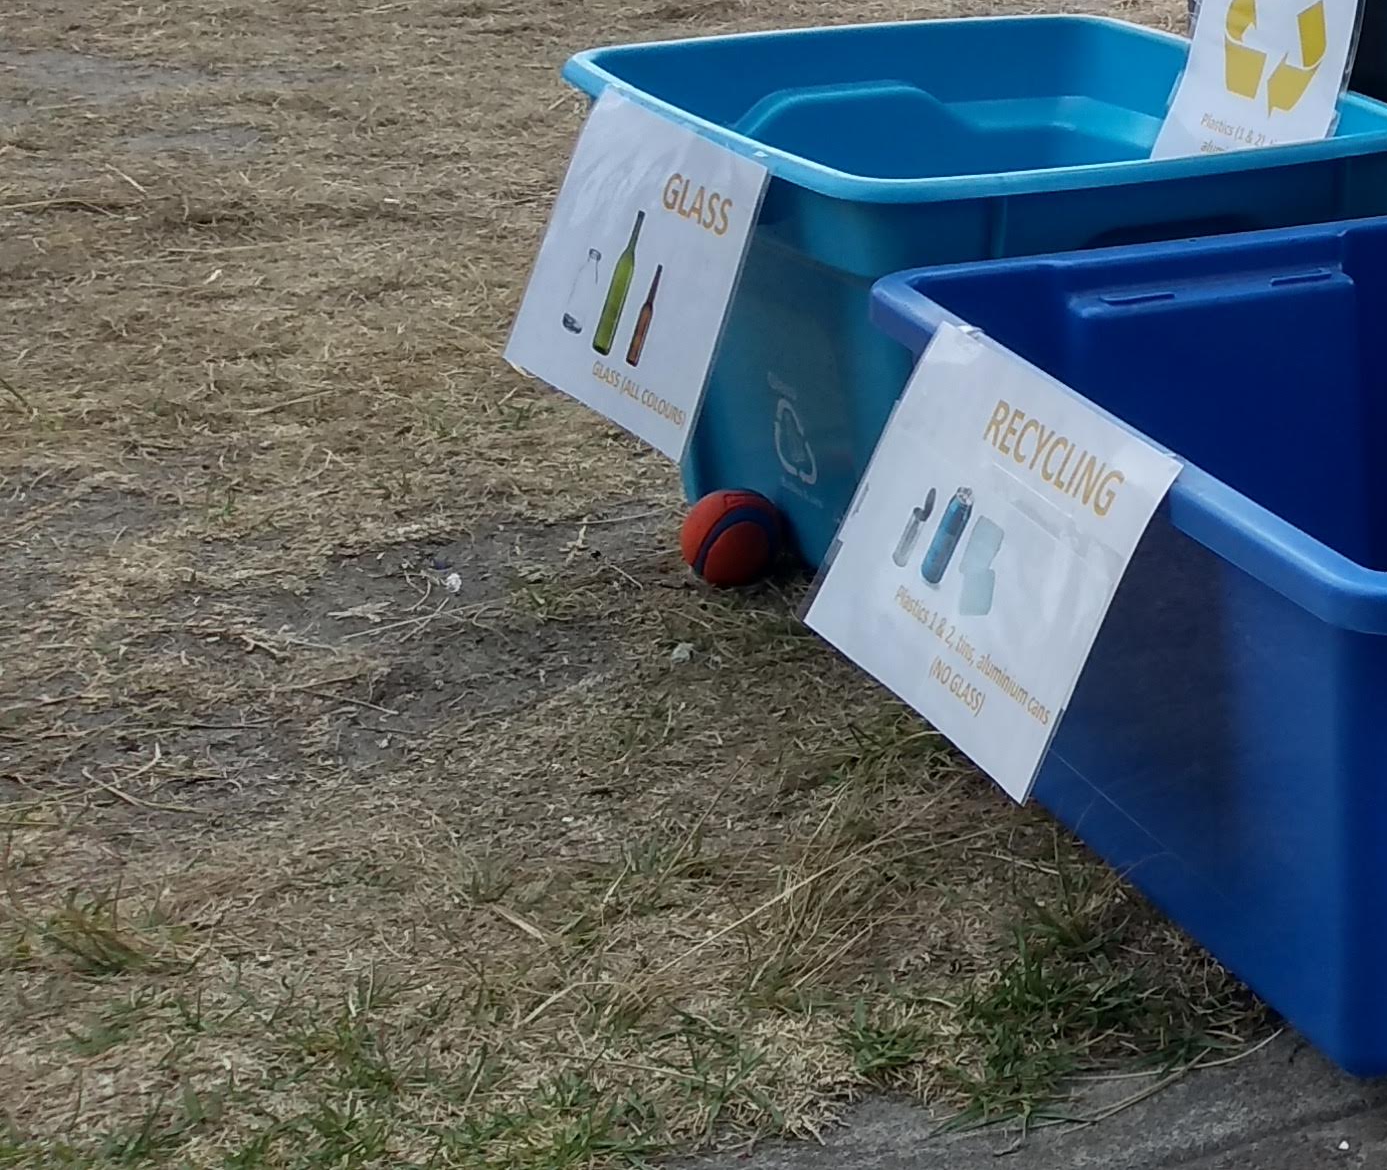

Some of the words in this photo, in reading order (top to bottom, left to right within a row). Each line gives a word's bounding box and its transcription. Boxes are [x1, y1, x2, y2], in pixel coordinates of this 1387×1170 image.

[663, 173, 733, 236] GLASS
[592, 360, 621, 388] GLASS
[983, 399, 1125, 516] RECYCLING
[894, 584, 930, 625] Plastics
[936, 617, 947, 638] &
[955, 634, 976, 667] tins,
[976, 653, 1029, 708] aluminium
[1027, 696, 1051, 725] cans
[929, 656, 952, 685] (NO
[950, 673, 986, 718] GLASS)
